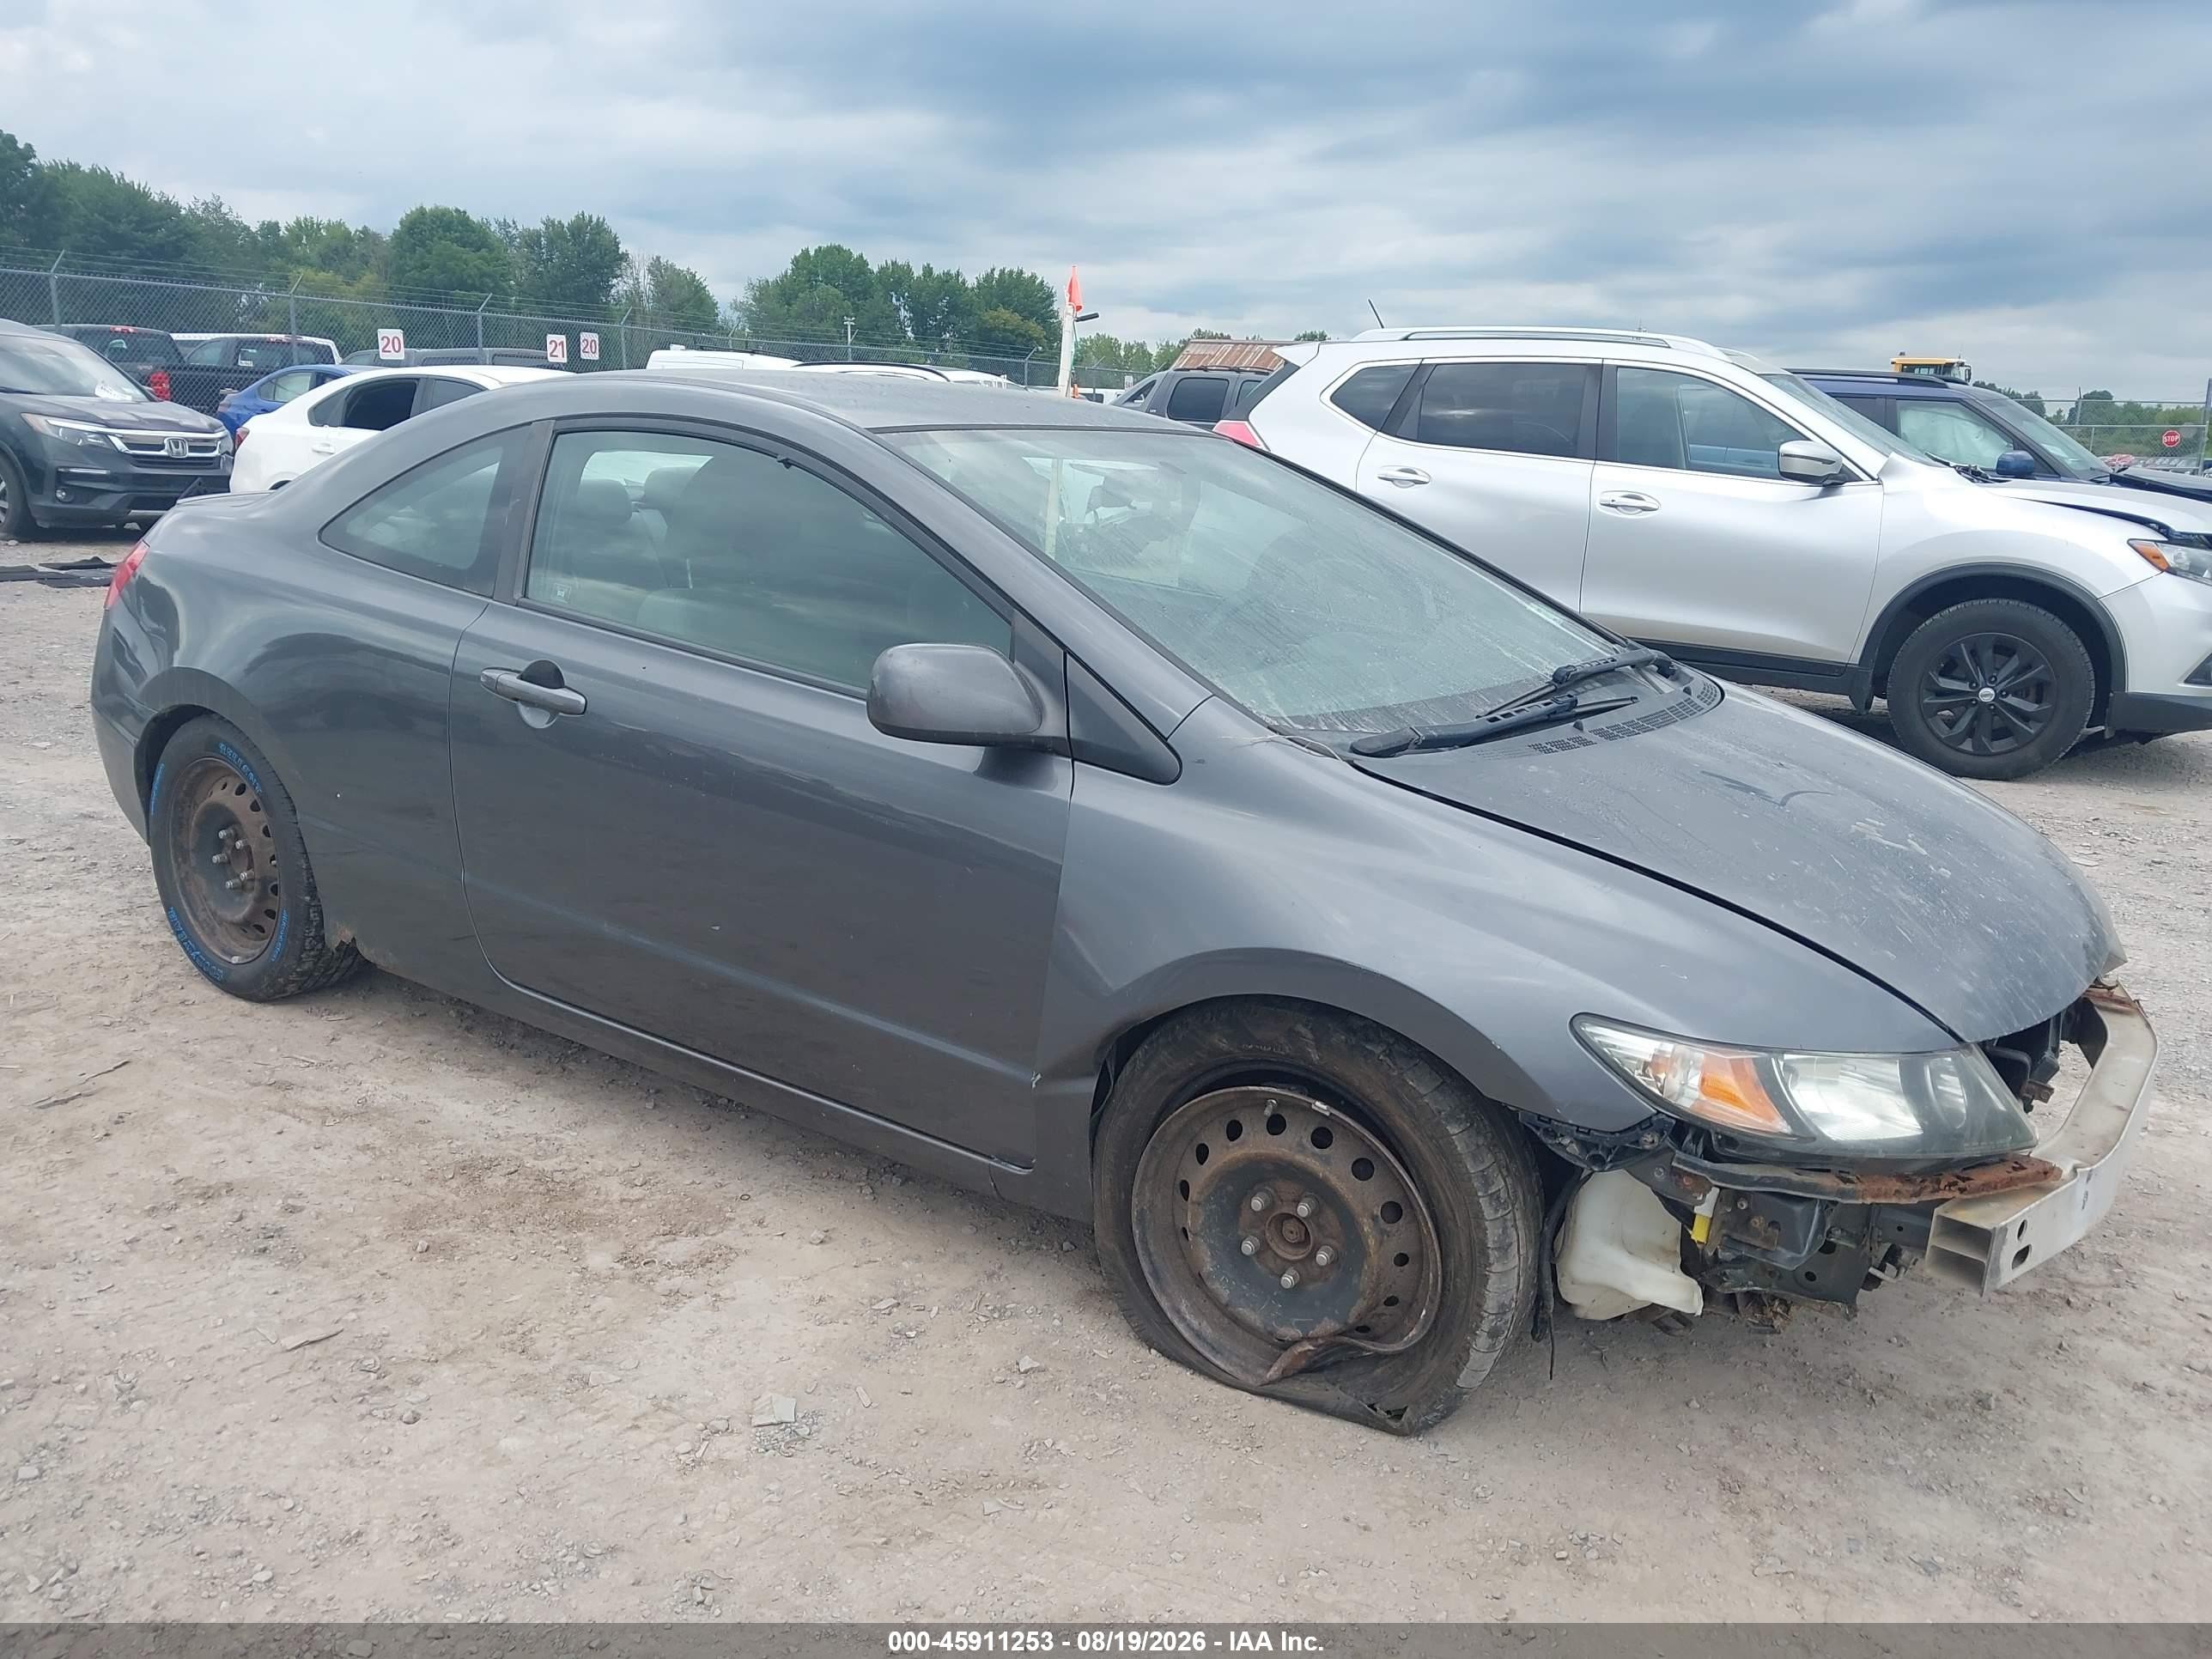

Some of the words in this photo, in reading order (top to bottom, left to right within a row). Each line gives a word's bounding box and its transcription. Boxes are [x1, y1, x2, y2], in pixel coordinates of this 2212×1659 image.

[380, 335, 402, 354] 20
[549, 339, 565, 358] 21
[581, 338, 598, 355] 20
